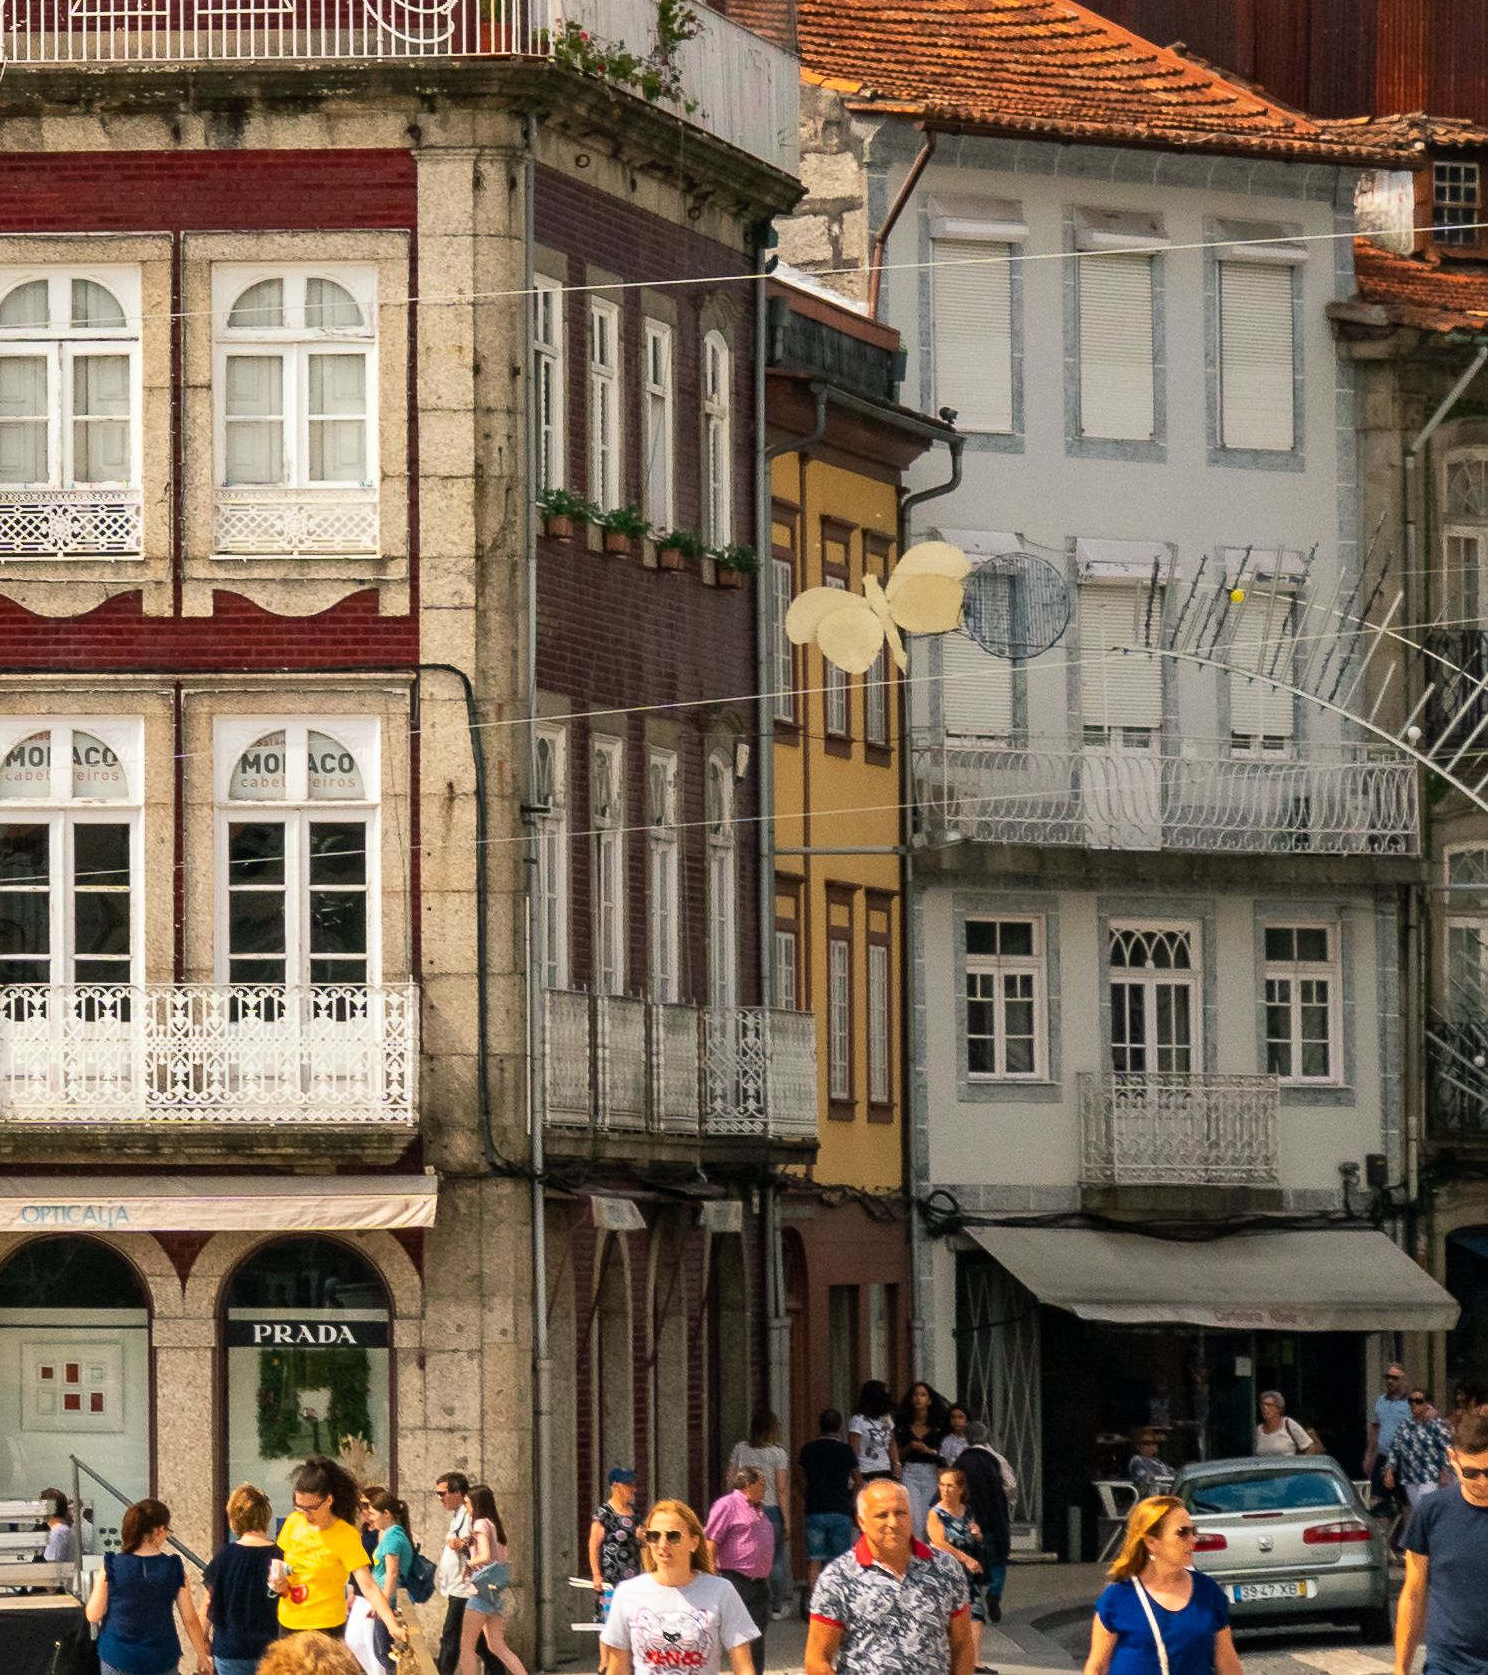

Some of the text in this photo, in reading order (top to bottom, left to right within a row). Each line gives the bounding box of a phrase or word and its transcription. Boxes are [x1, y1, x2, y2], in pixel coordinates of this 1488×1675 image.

[6, 746, 119, 767] MOACO
[240, 753, 355, 774] MOACO
[253, 1324, 358, 1345] PRADA
